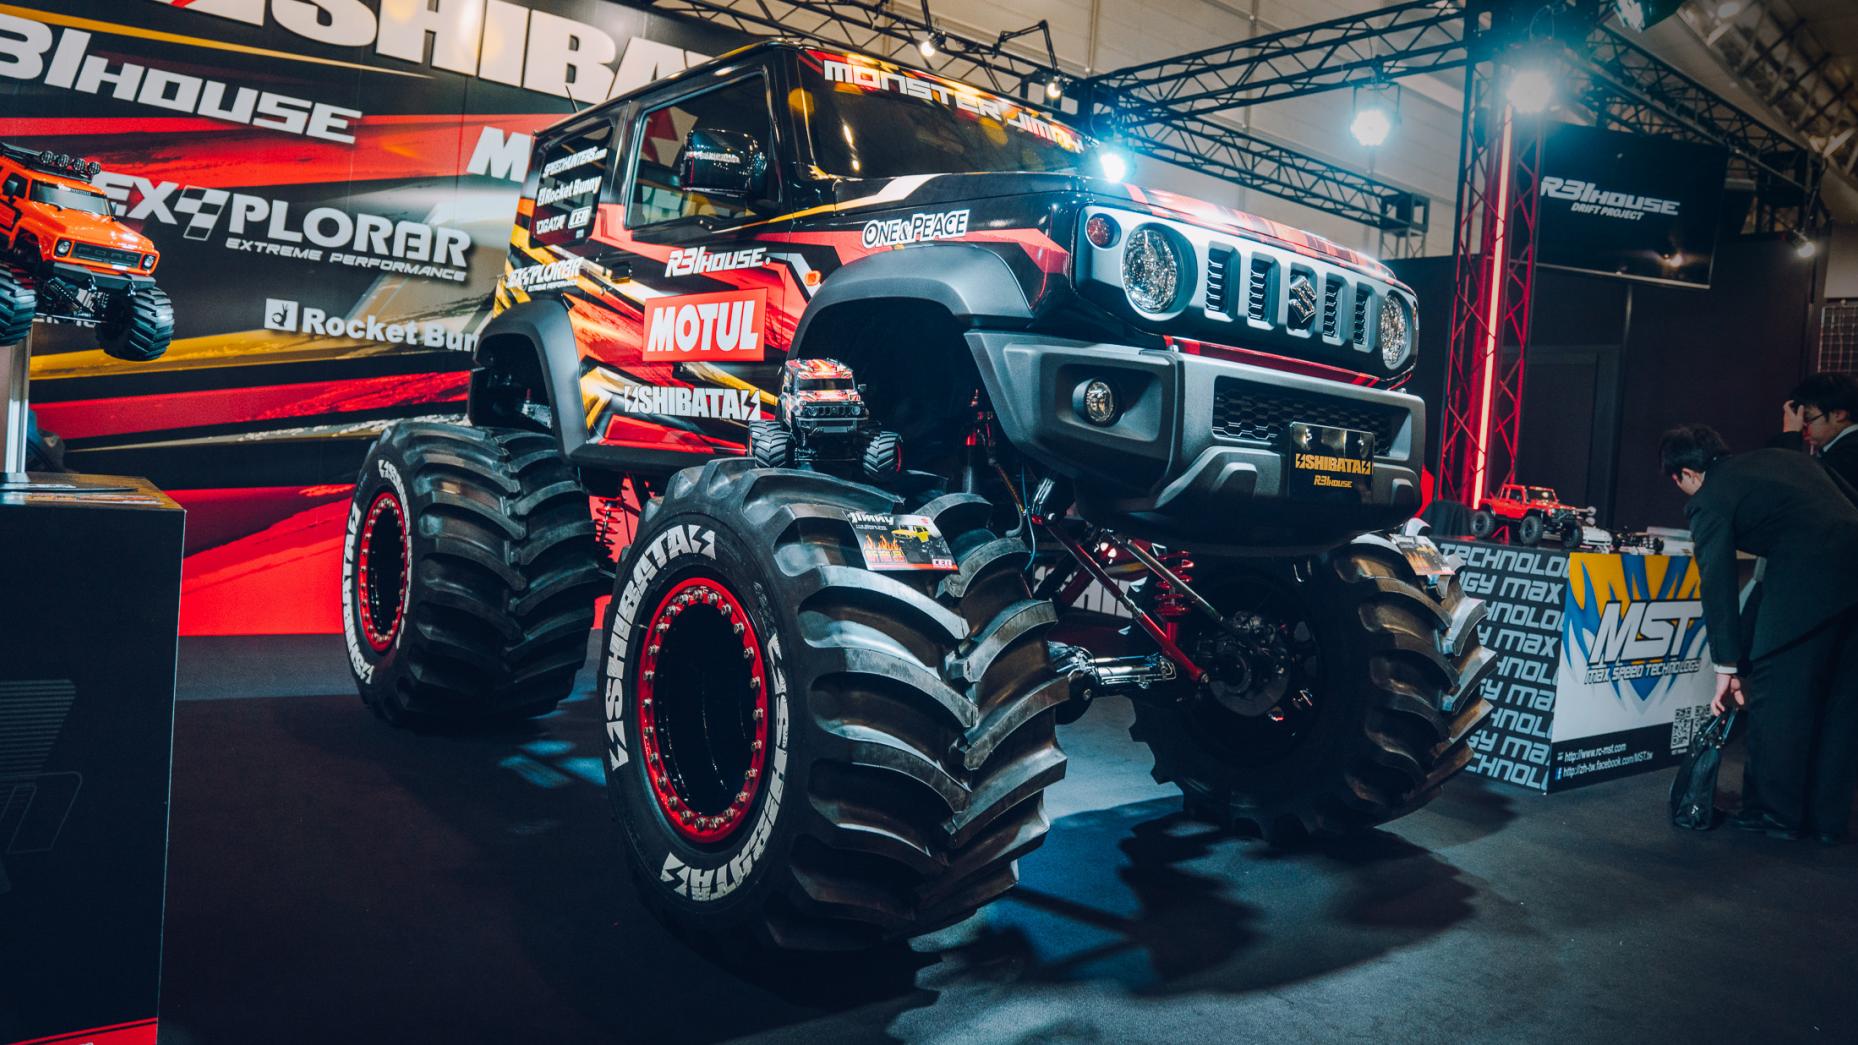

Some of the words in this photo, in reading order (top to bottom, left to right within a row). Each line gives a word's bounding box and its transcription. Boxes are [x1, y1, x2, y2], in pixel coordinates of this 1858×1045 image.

[1540, 176, 1680, 215] R31HOUSE
[1570, 202, 1601, 216] DRIFT
[1600, 206, 1645, 221] PROJECT
[225, 237, 323, 263] EXTREME
[329, 253, 467, 283] PERFORMANCE
[302, 307, 417, 346] Rocket
[647, 300, 759, 353] MOTUL
[637, 385, 742, 420] SHIBATA
[1304, 453, 1362, 475] SHIBATA
[605, 524, 695, 723] SHIBATA
[1588, 600, 1704, 664] MST
